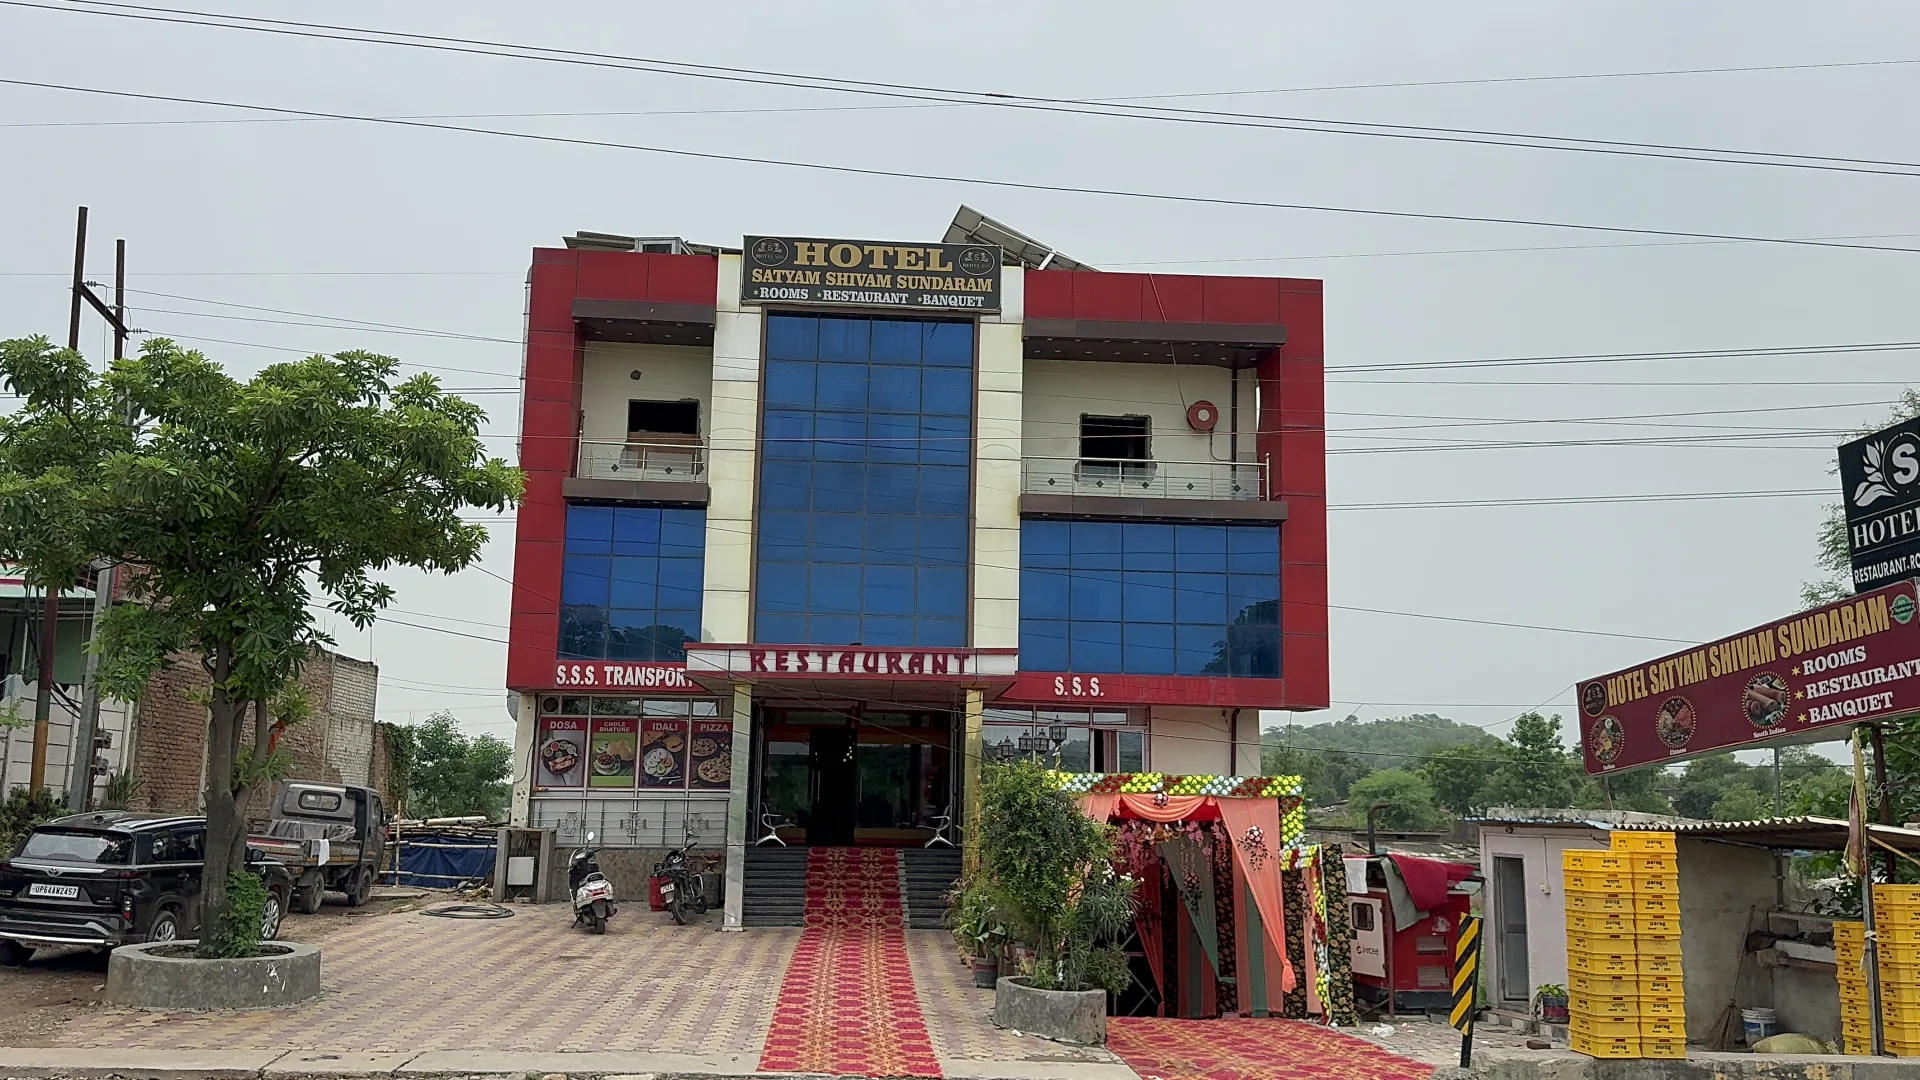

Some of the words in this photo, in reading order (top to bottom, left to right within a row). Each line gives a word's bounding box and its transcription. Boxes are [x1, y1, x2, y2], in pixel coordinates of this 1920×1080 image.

[793, 241, 953, 272] HOTEL
[751, 268, 821, 285] SATYAM
[825, 271, 892, 289] SHIVAM
[896, 275, 992, 292] SUNDARAM
[759, 287, 809, 300] ROOMS
[823, 290, 909, 304] RESTAURANT
[922, 294, 985, 308] BANQUET
[749, 649, 970, 675] RESTAURANT
[1606, 668, 1649, 707] HOTEL
[1648, 649, 1708, 696] SATYAM
[1708, 629, 1776, 678] SHIVAM
[1777, 594, 1890, 659] SUNDARAM
[1802, 645, 1867, 676] ROOMS
[556, 664, 599, 686] S.S.S.
[1054, 676, 1105, 697] S.S.S.
[1805, 658, 1920, 699] RESTAURANT
[1808, 691, 1893, 724] BANQUET
[550, 720, 578, 730] DOSA
[652, 722, 678, 731] IDALI
[700, 723, 729, 732] PIZZA
[1753, 728, 1769, 739] South
